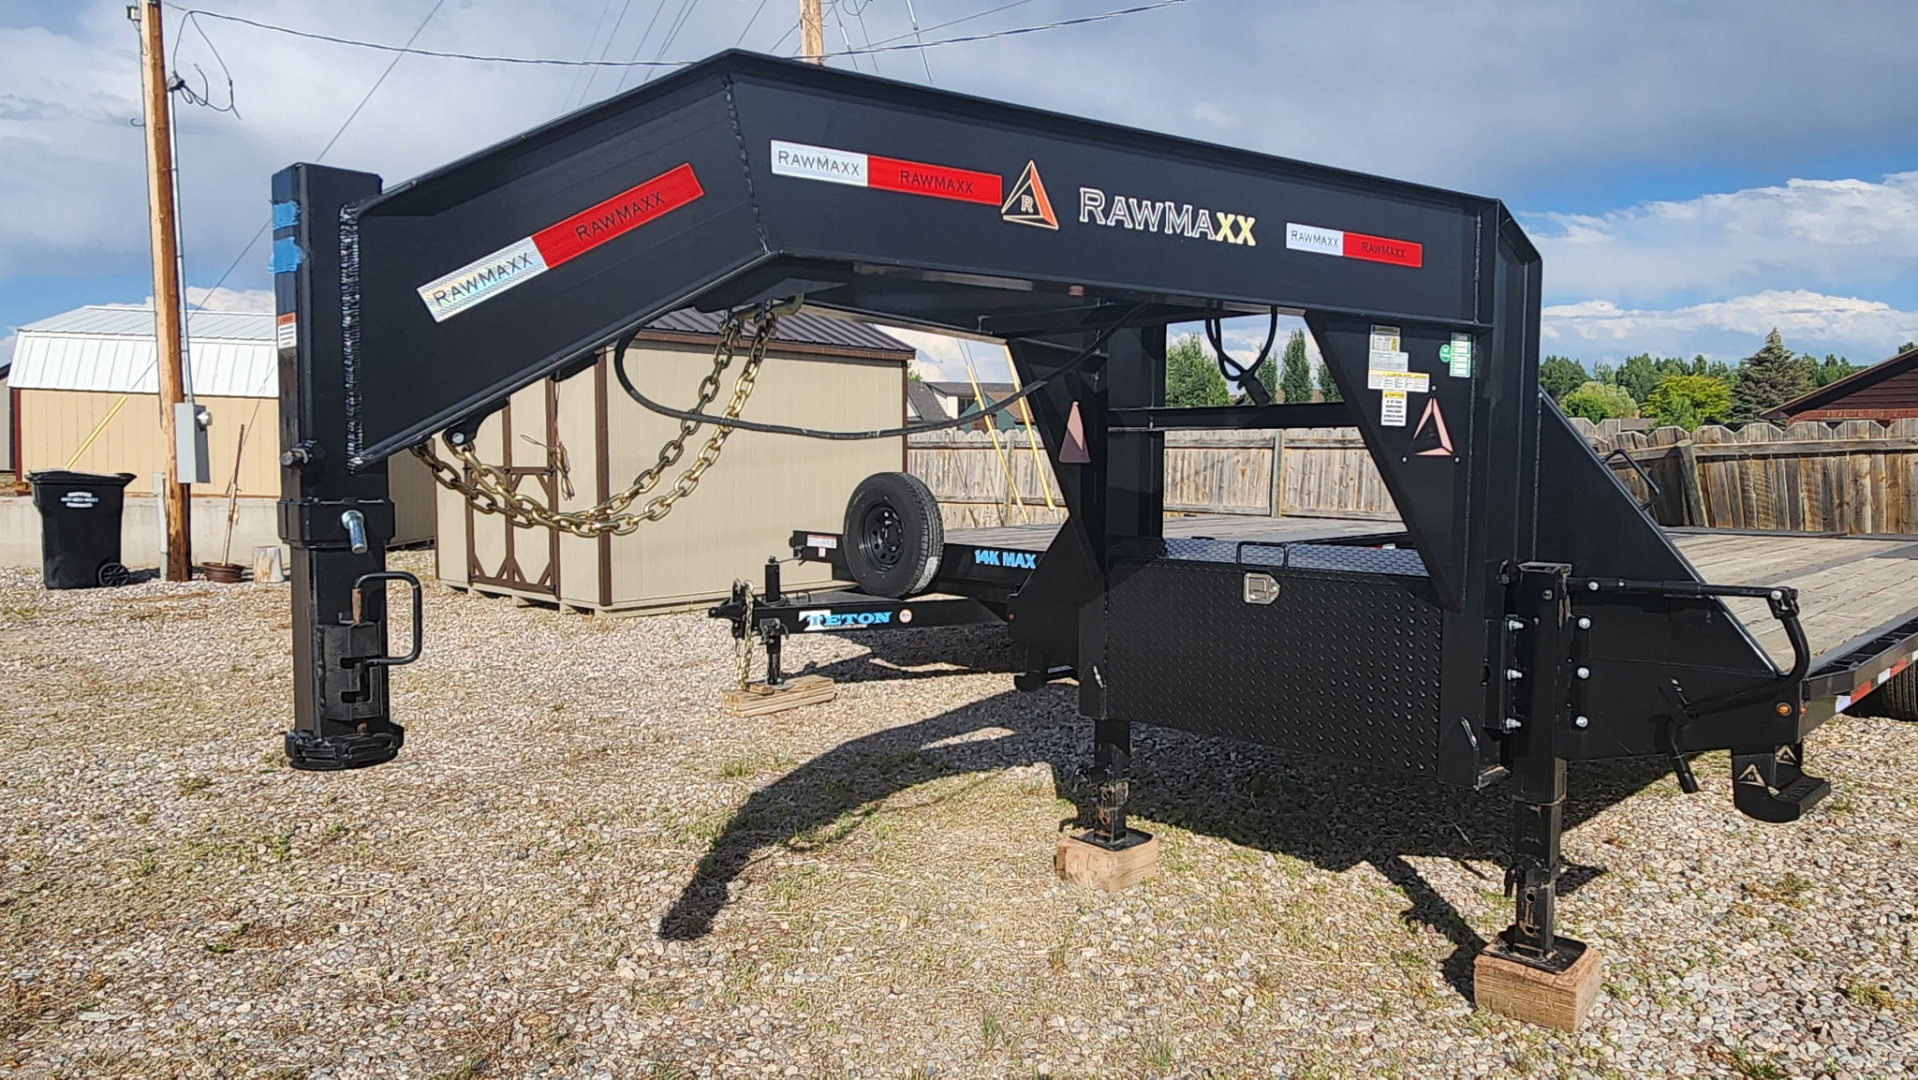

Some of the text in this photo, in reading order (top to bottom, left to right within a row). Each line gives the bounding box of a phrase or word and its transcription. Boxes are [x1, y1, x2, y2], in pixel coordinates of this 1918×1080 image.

[778, 150, 973, 194] RAWMAXX RAWMAXX
[1021, 195, 1034, 213] R
[1080, 187, 1256, 246] RAWMAXX
[433, 191, 665, 306] RAWMAXX RAWMAXX
[1291, 230, 1407, 258] RAWMAXX RAWMAXX
[974, 549, 1036, 569] 14K MAX
[799, 609, 892, 631] TETON
